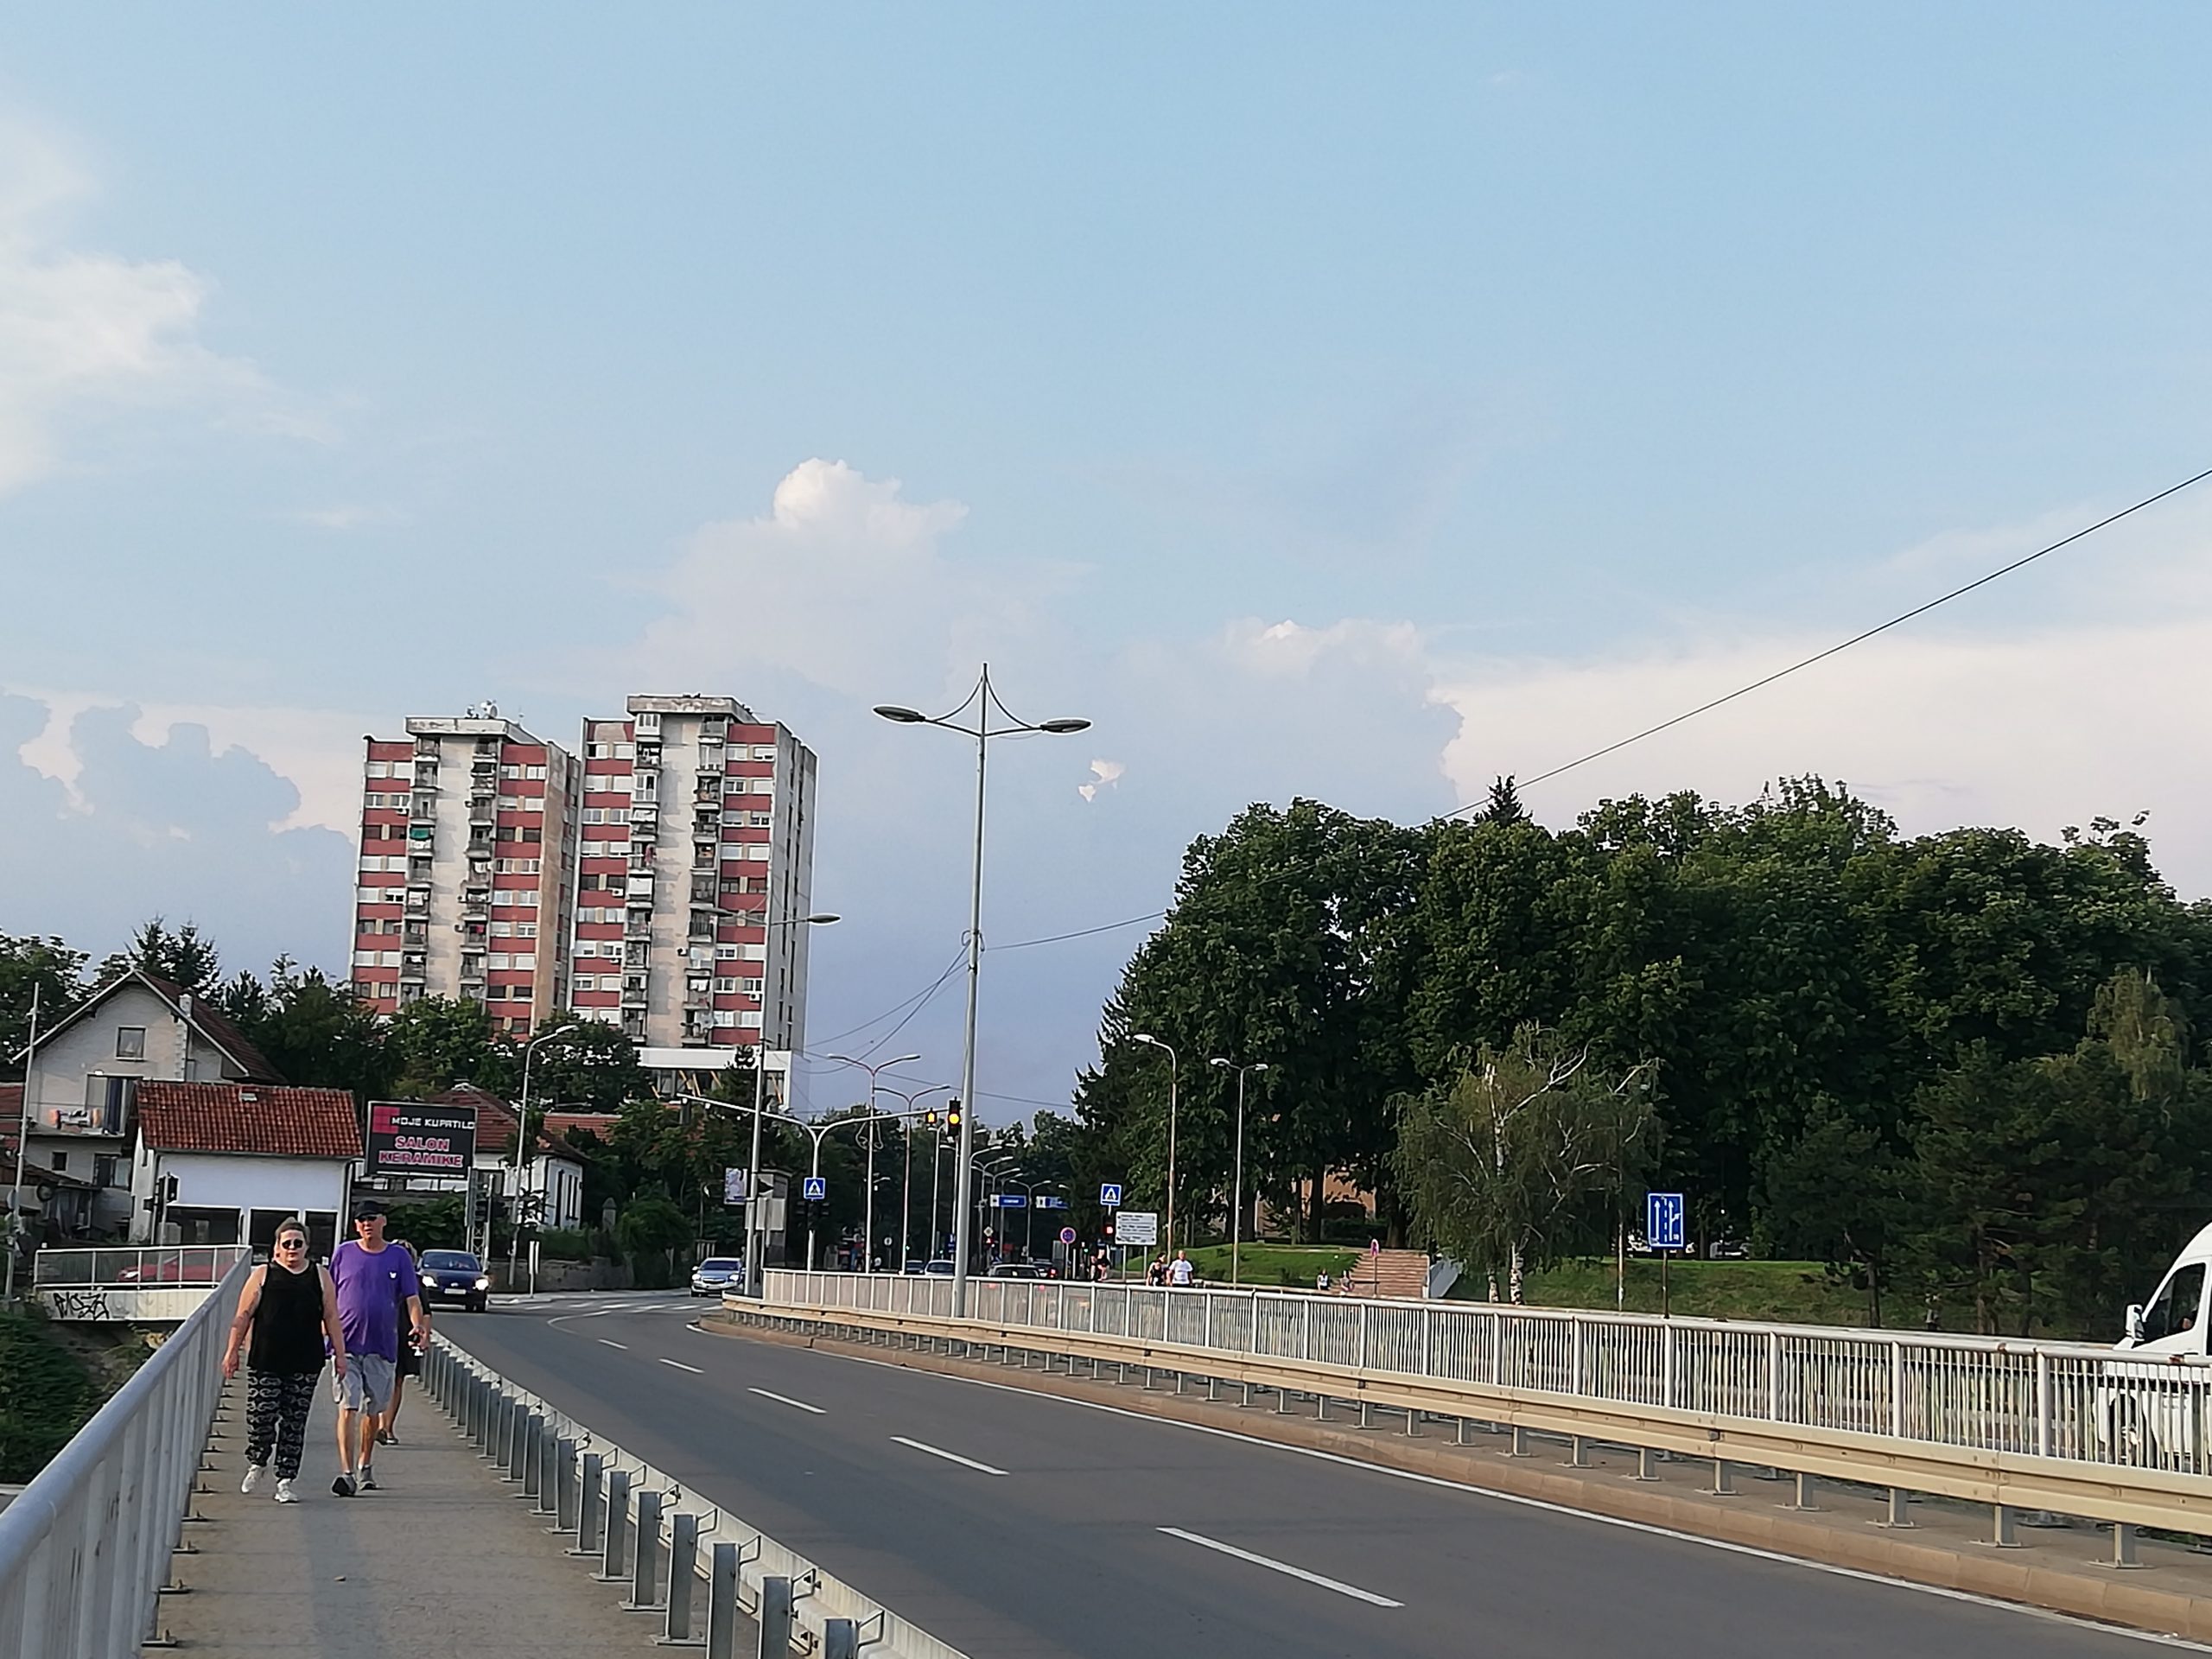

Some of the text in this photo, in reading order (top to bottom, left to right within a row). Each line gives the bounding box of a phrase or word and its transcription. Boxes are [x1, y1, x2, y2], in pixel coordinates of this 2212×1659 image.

[391, 1116, 475, 1129] MOJE KUPATILO
[395, 1135, 450, 1152] SALON
[378, 1150, 463, 1167] KERAMIKE
